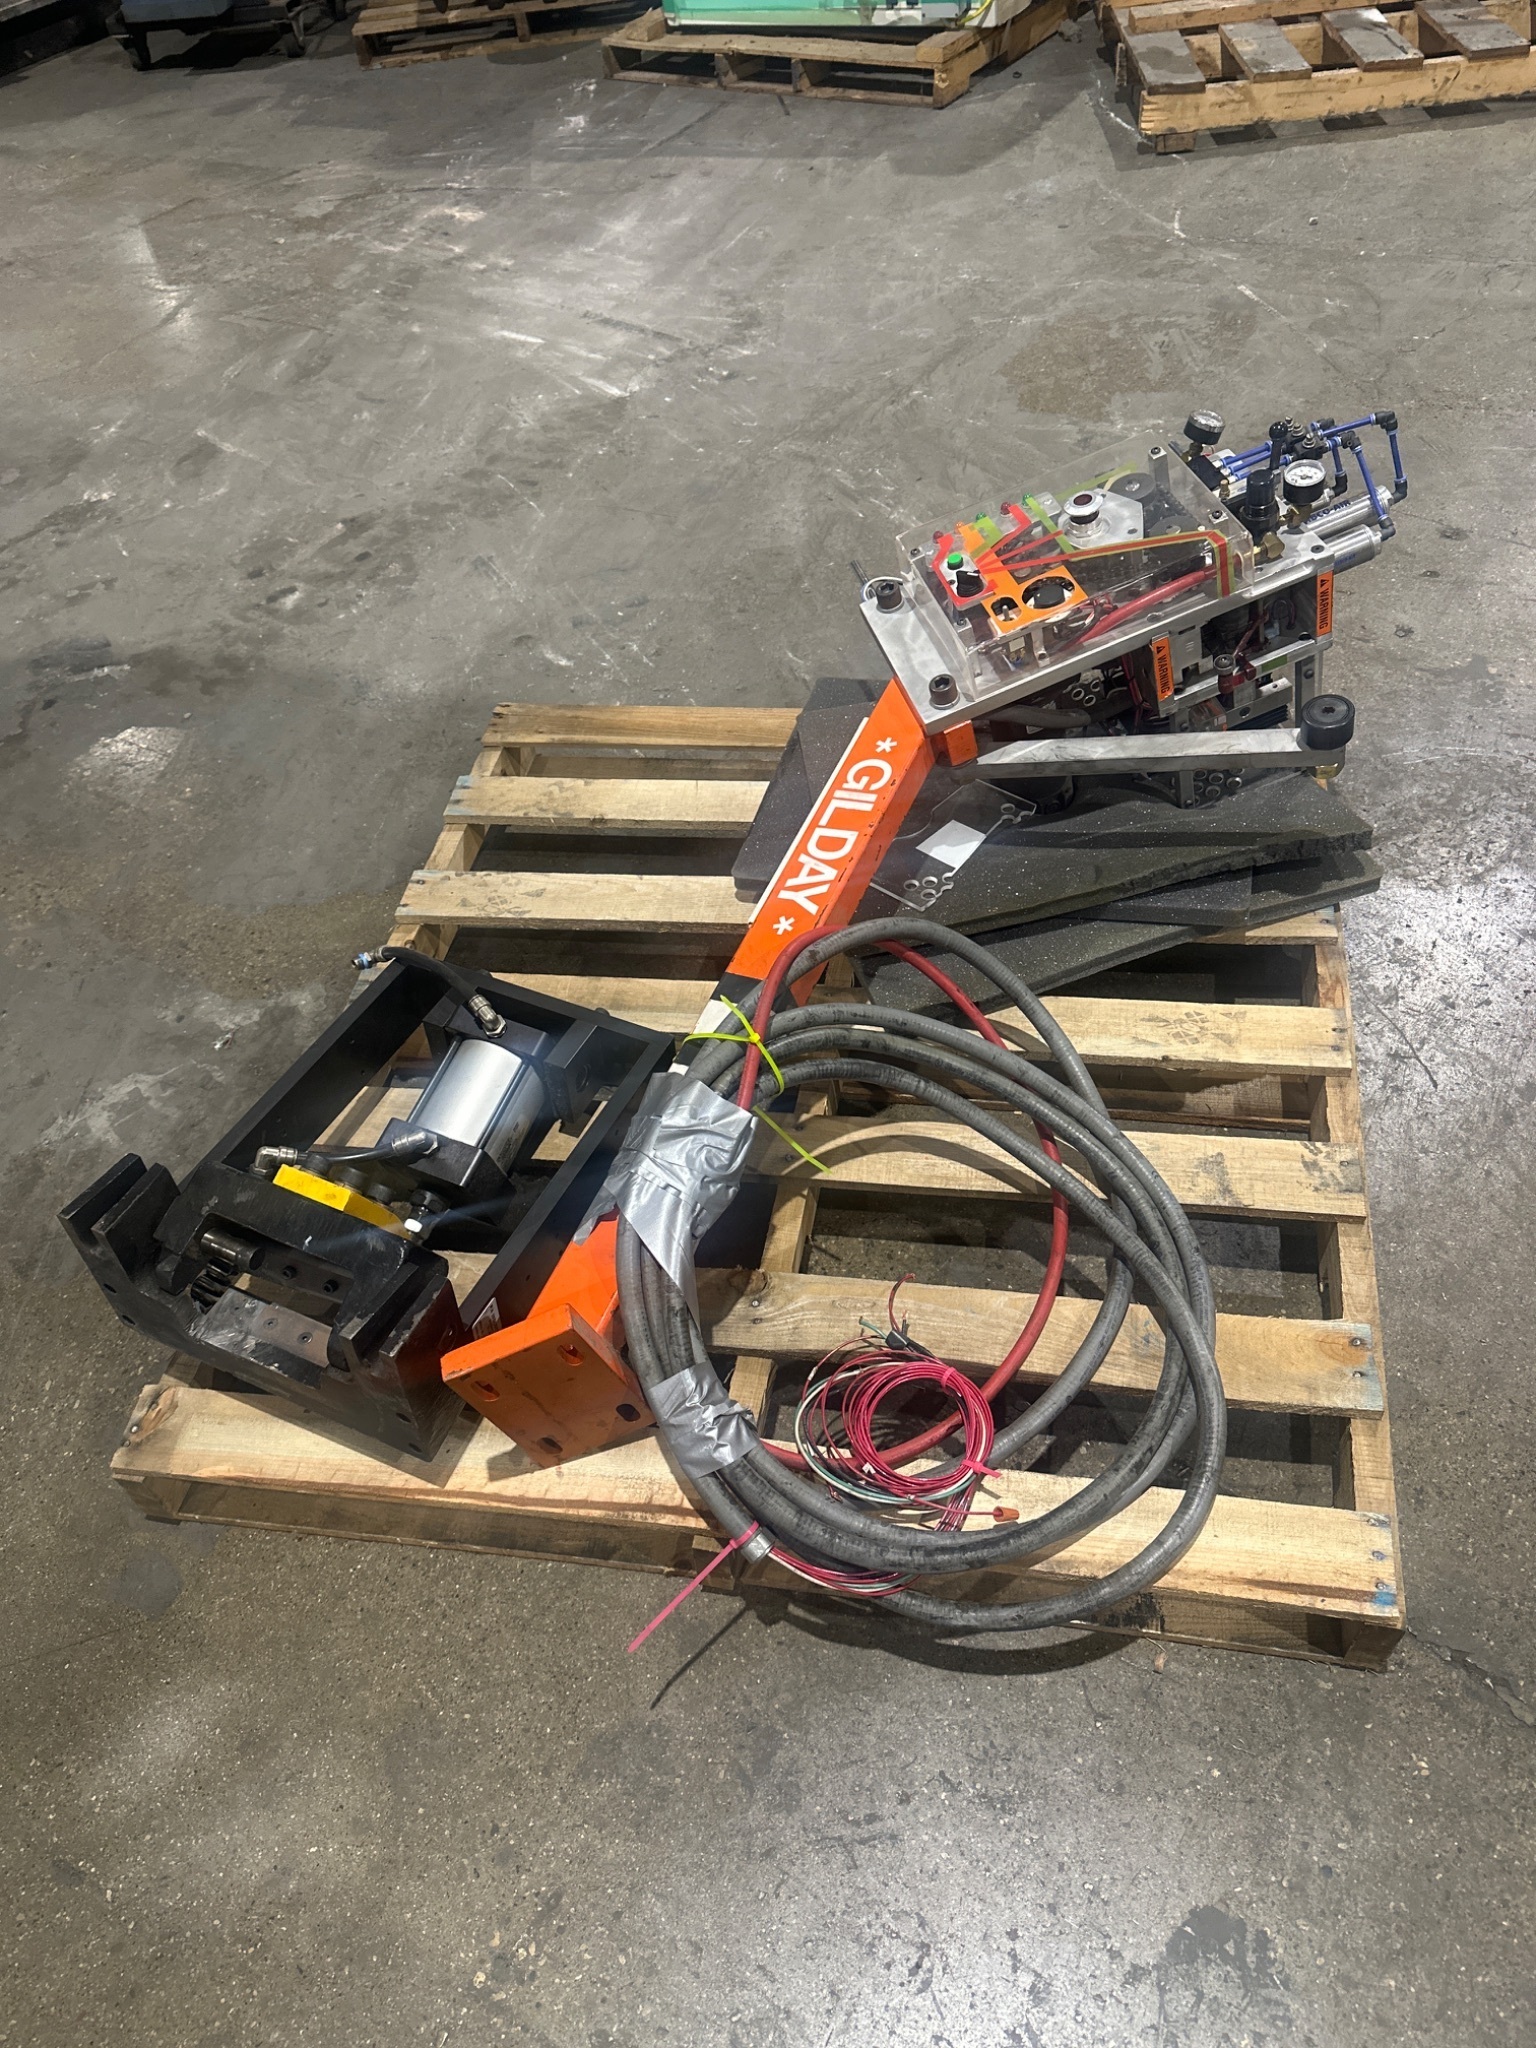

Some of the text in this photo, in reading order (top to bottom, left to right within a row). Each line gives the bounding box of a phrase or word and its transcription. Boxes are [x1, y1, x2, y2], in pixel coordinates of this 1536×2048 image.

[1319, 588, 1329, 630] WARNING
[1157, 654, 1171, 694] WARNING
[777, 758, 892, 915] GILDAY
